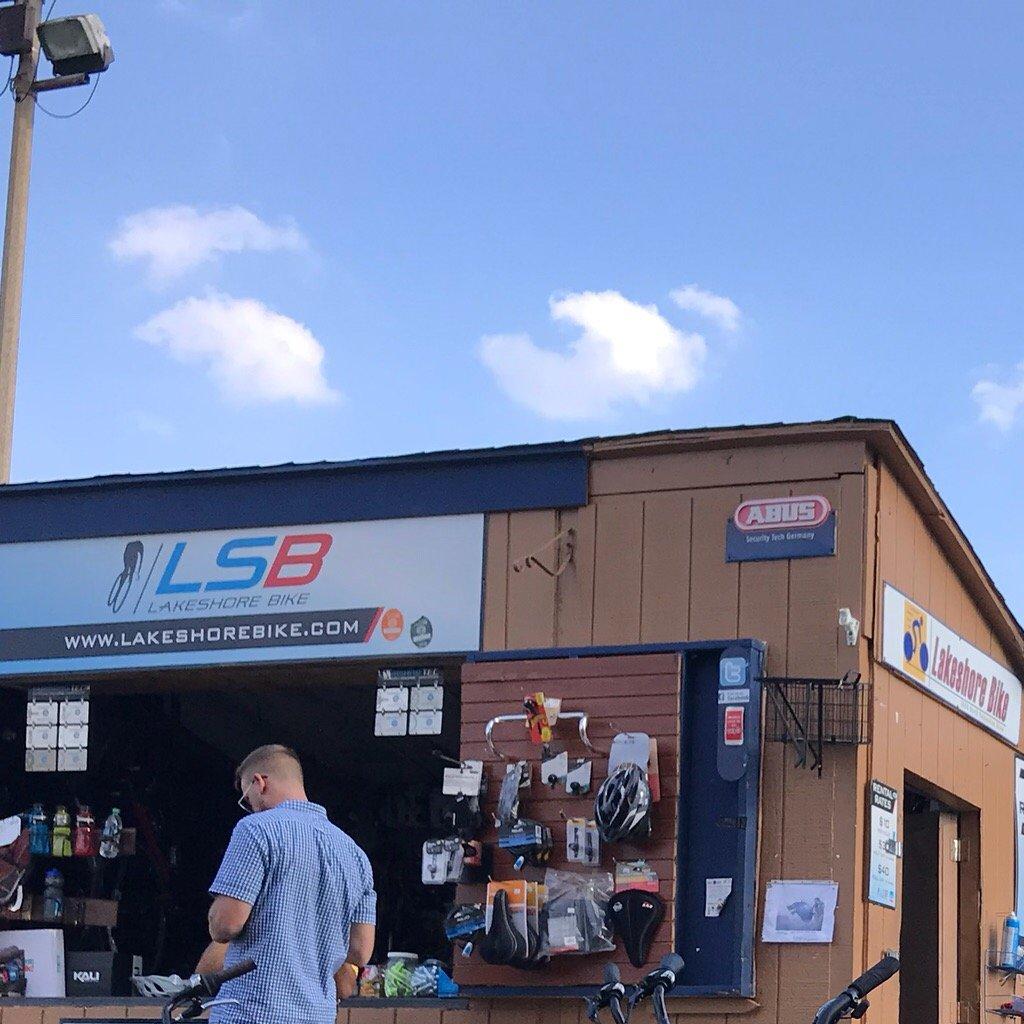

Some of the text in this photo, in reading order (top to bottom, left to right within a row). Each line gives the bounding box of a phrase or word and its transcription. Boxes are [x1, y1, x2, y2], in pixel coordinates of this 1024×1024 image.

[746, 501, 816, 526] ABUS
[746, 531, 815, 544] Security Tech Germany
[155, 533, 334, 596] LSB
[148, 592, 311, 614] LAKESHORE BIKE
[64, 619, 360, 650] WWW.LAKESHOREBIKE.COM
[931, 635, 988, 709] Lakeshore
[986, 675, 1010, 723] Bike
[872, 782, 894, 800] RENTAL
[874, 793, 892, 810] RATES
[73, 970, 100, 983] KALI
